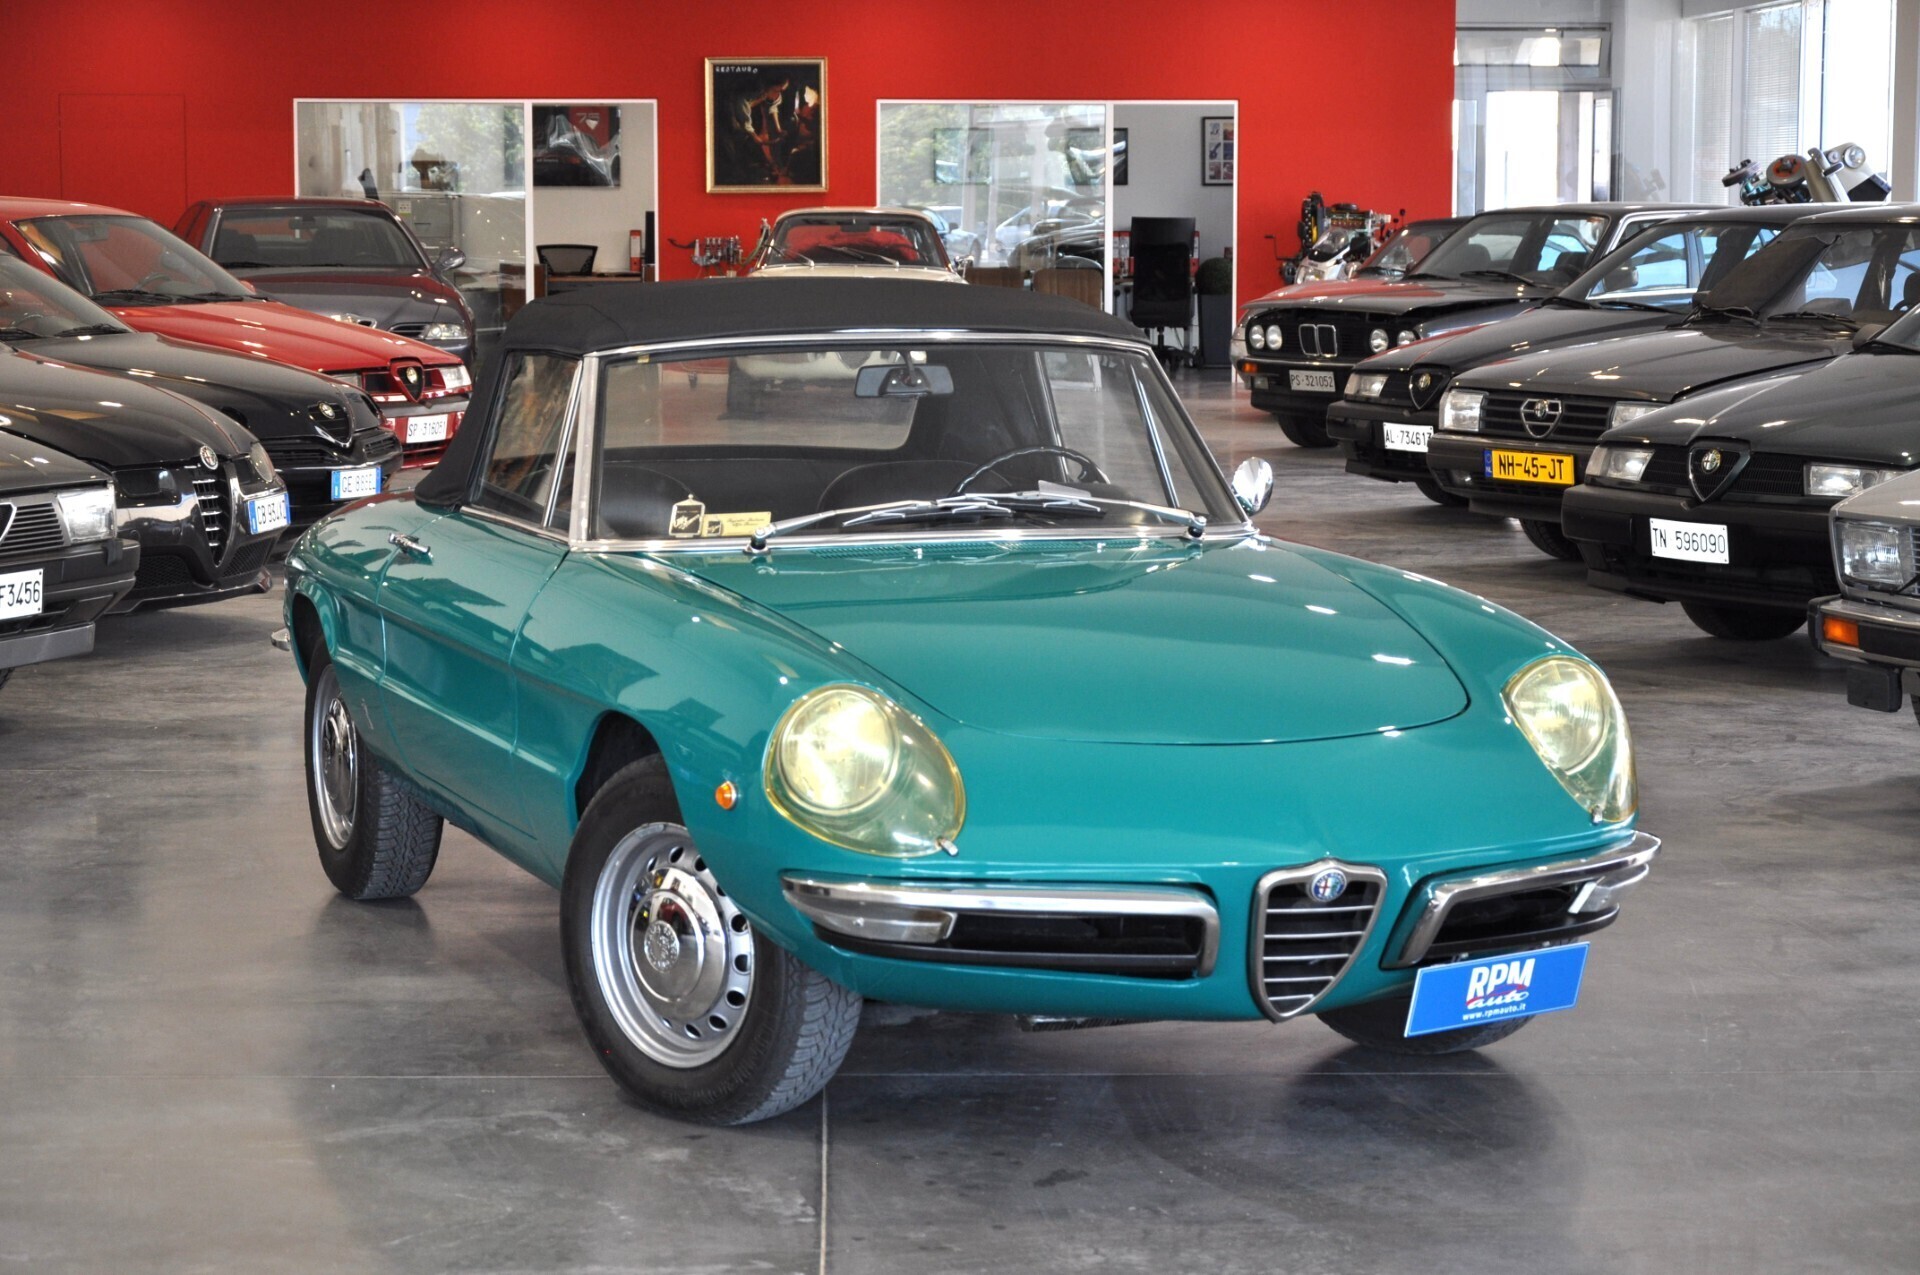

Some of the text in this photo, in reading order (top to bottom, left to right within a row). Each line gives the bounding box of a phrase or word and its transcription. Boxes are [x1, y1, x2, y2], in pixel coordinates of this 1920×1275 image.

[1499, 454, 1564, 480] NH-45-JT
[1652, 527, 1726, 553] TN 596090
[1466, 958, 1536, 1002] RPM
[1463, 1003, 1526, 1021] www.rpmauto.it
[1467, 989, 1529, 1010] auto
